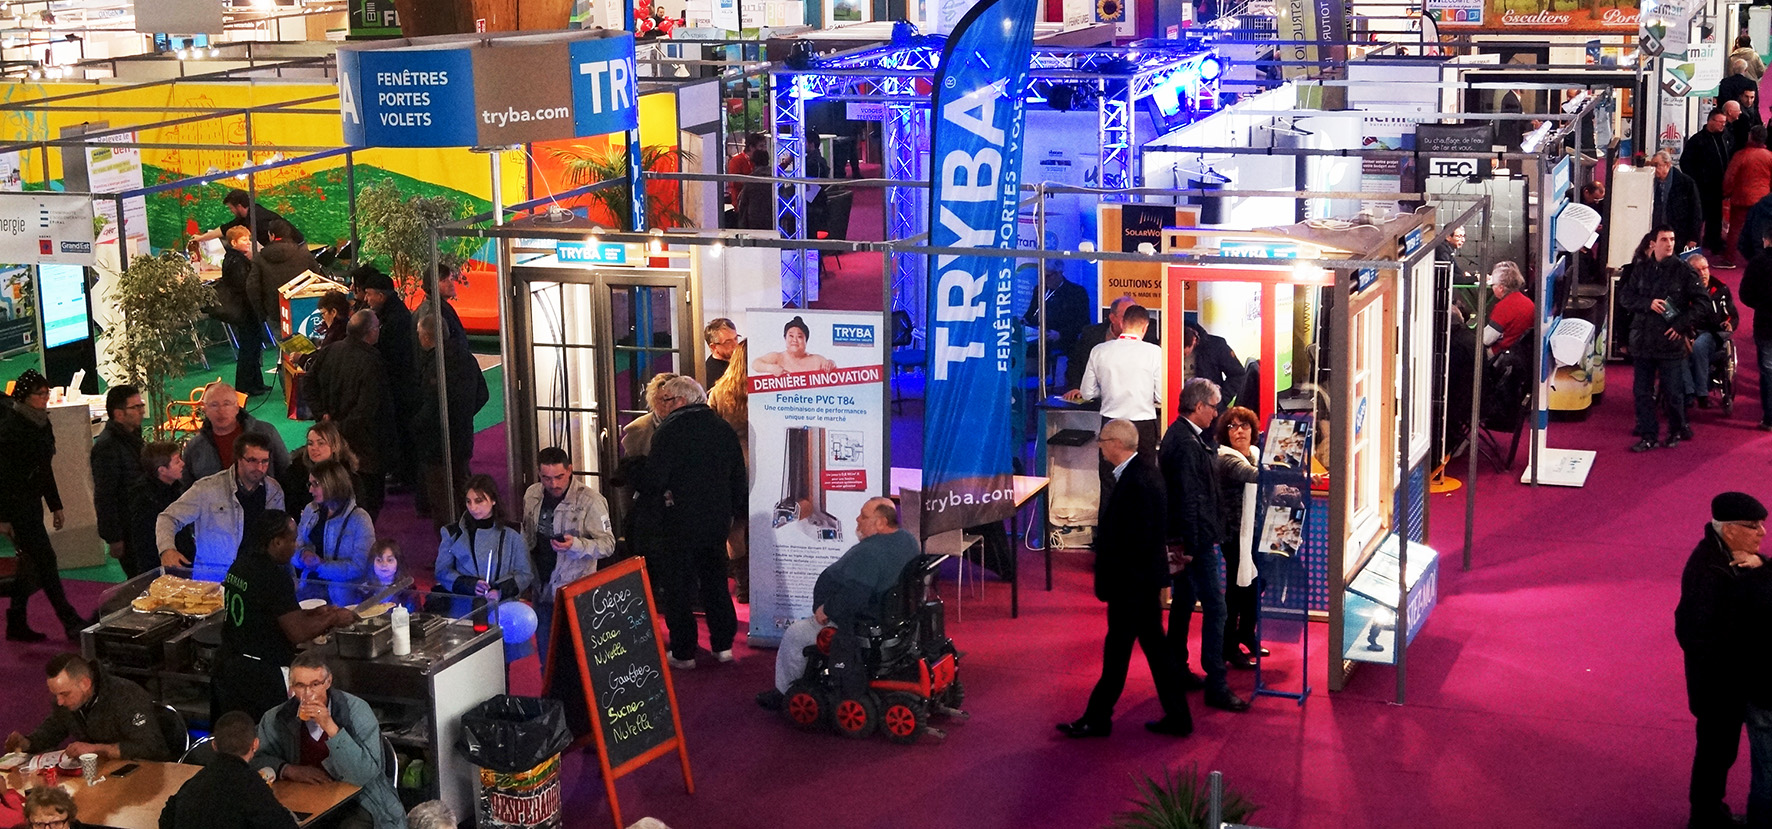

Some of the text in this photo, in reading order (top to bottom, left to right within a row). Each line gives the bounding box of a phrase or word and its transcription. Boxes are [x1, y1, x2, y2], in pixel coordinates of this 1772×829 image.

[1502, 10, 1572, 24] Escaliers
[377, 69, 448, 86] FENÊTRES
[379, 92, 431, 106] PORTES
[380, 112, 432, 126] VOLETS
[482, 107, 569, 127] tryba.com
[1435, 161, 1473, 177] TEC
[1000, 169, 1016, 250] PORTES
[559, 247, 600, 260] TRYBA
[1109, 278, 1152, 289] SOLUTIONS
[993, 268, 1012, 372] FENÊTRES
[834, 327, 872, 338] TRYBA
[753, 369, 879, 391] DERNIÈRE INNOVATION
[776, 394, 855, 405] Fenêtre PVC T84
[777, 405, 815, 413] combinaison
[825, 407, 867, 415] performances
[925, 489, 1013, 512] tryba.com
[592, 588, 632, 615] Crêpes
[594, 642, 627, 666] Nutella
[613, 713, 655, 744] Nutella
